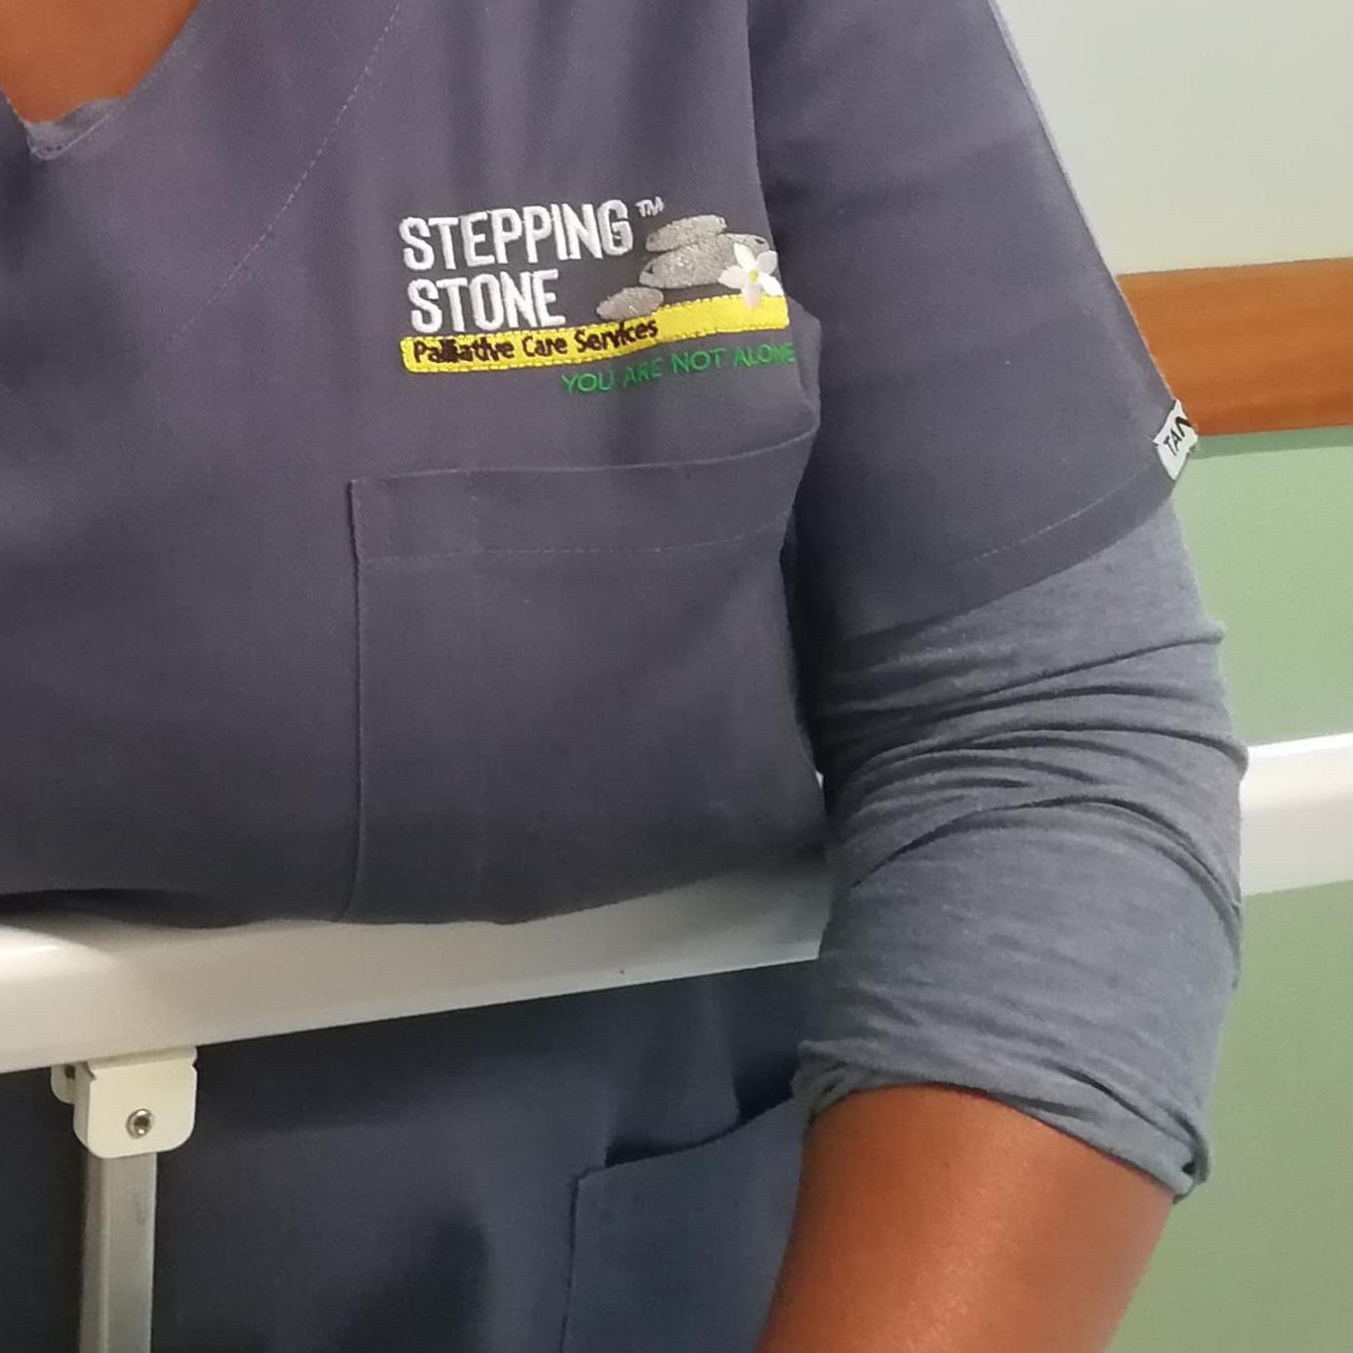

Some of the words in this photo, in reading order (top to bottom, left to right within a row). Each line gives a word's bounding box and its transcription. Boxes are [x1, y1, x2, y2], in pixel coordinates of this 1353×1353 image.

[399, 199, 634, 271] STEPPING
[407, 269, 566, 333] STONE
[413, 336, 515, 363] Palliative
[522, 335, 568, 357] Care
[574, 321, 658, 353] Services
[561, 372, 614, 395] YOU
[623, 357, 662, 388] ARE
[670, 347, 726, 374] NOT
[733, 343, 795, 373] ALONE
